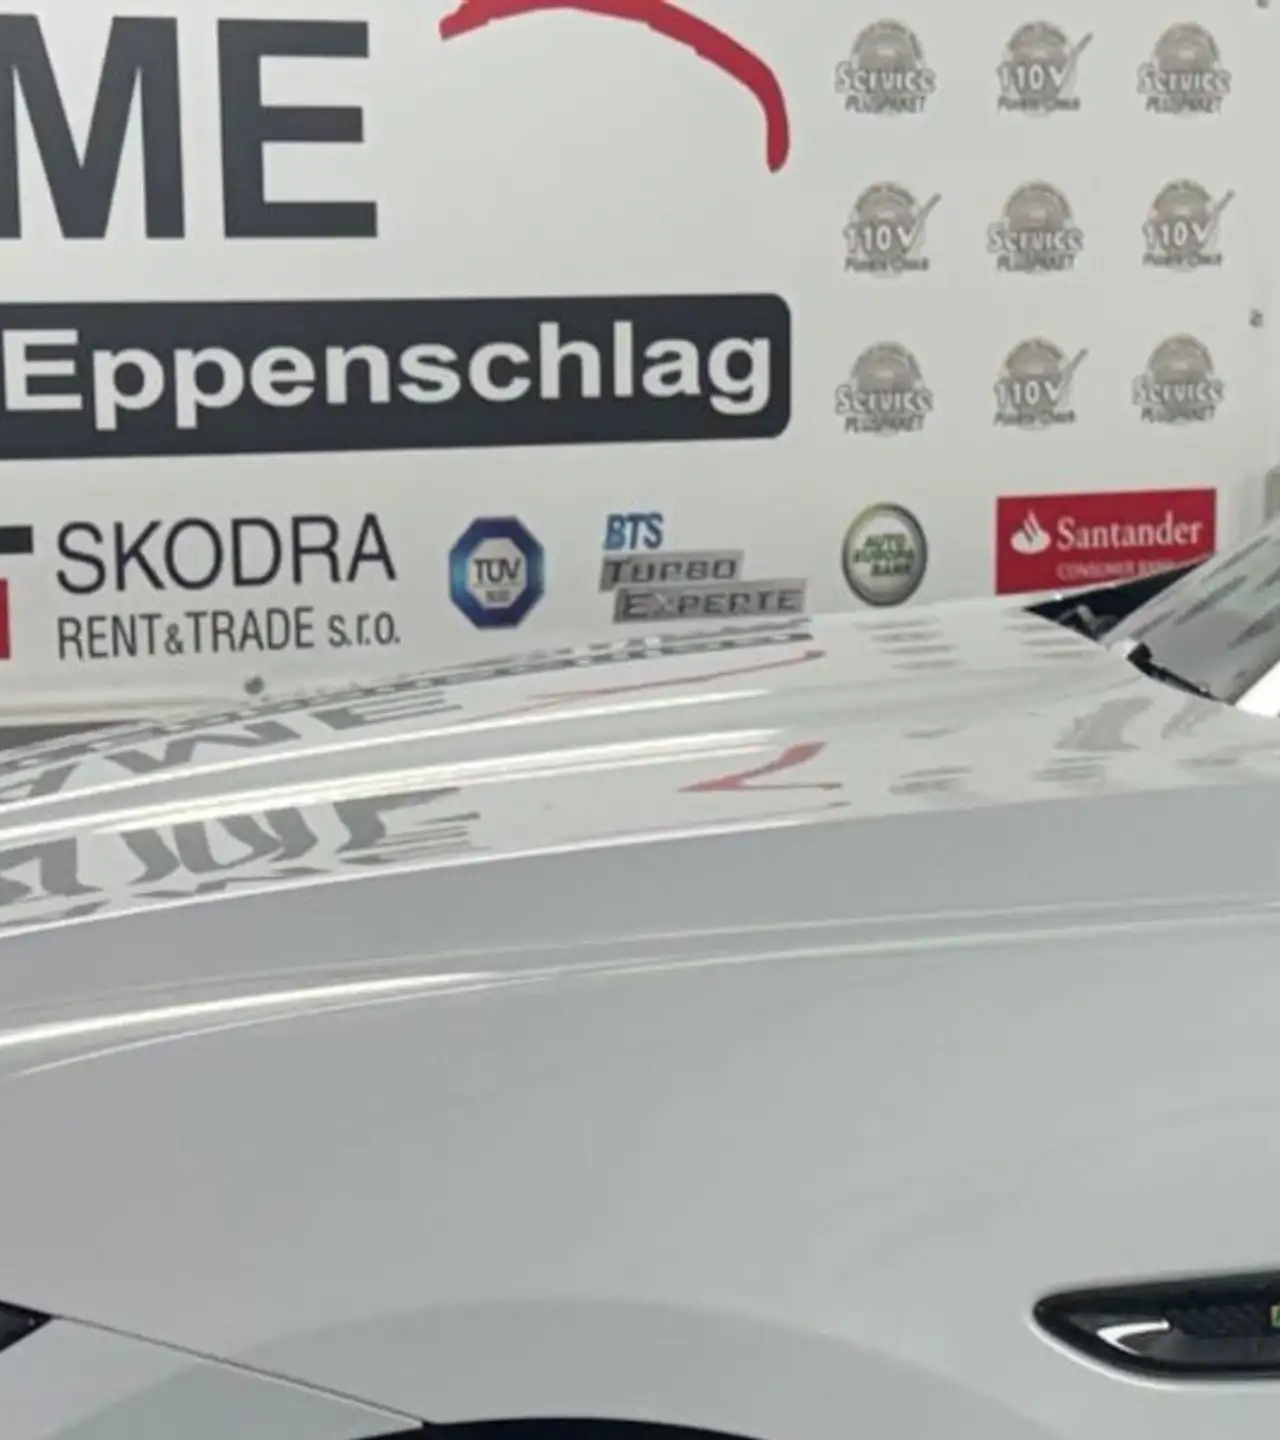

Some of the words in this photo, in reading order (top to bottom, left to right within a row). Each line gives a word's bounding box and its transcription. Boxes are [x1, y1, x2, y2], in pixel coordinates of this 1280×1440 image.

[2, 320, 771, 430] Eppenschlag
[56, 513, 399, 595] SKODRA
[603, 513, 665, 550] BTS
[1056, 508, 1205, 552] Santander
[58, 606, 316, 660] RENT&TRADE
